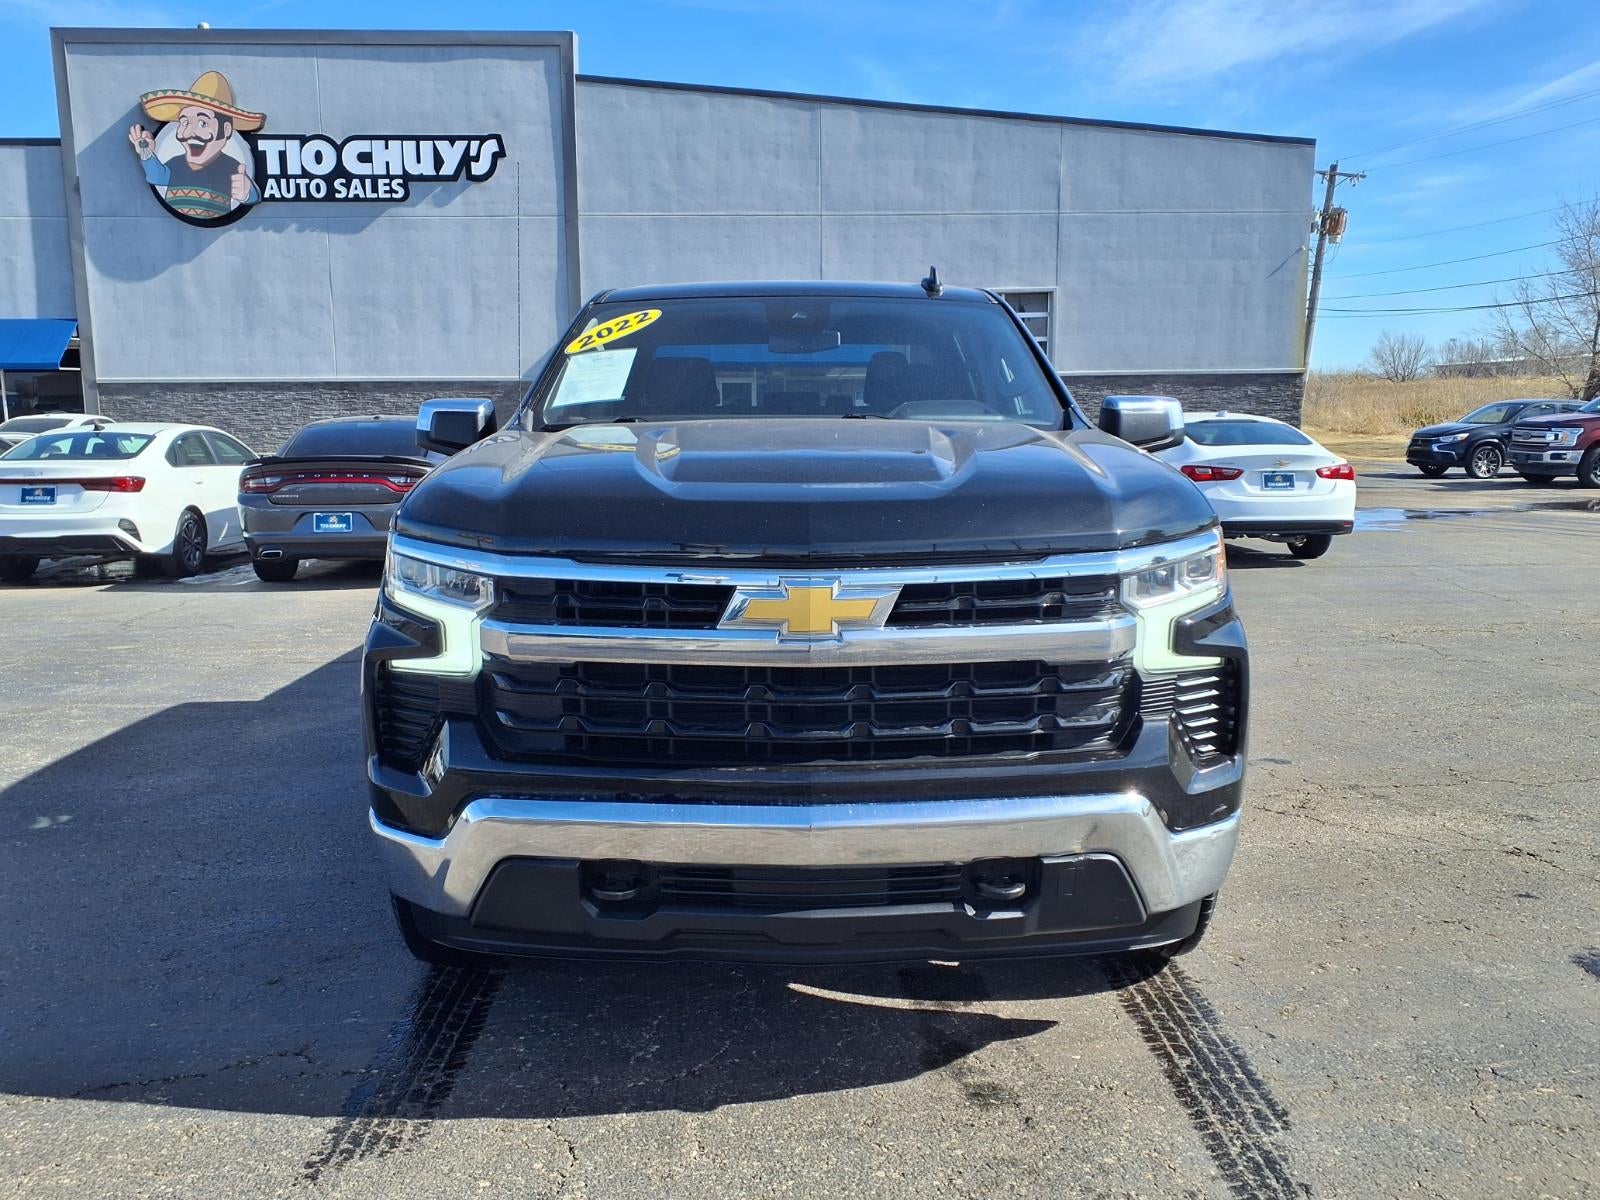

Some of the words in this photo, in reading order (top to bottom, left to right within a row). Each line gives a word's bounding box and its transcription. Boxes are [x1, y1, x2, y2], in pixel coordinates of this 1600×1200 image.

[257, 139, 337, 176] TIO
[341, 138, 500, 176] CHUY'S
[263, 178, 327, 199] AUTO
[333, 178, 405, 199] SALES
[577, 311, 652, 349] 2022
